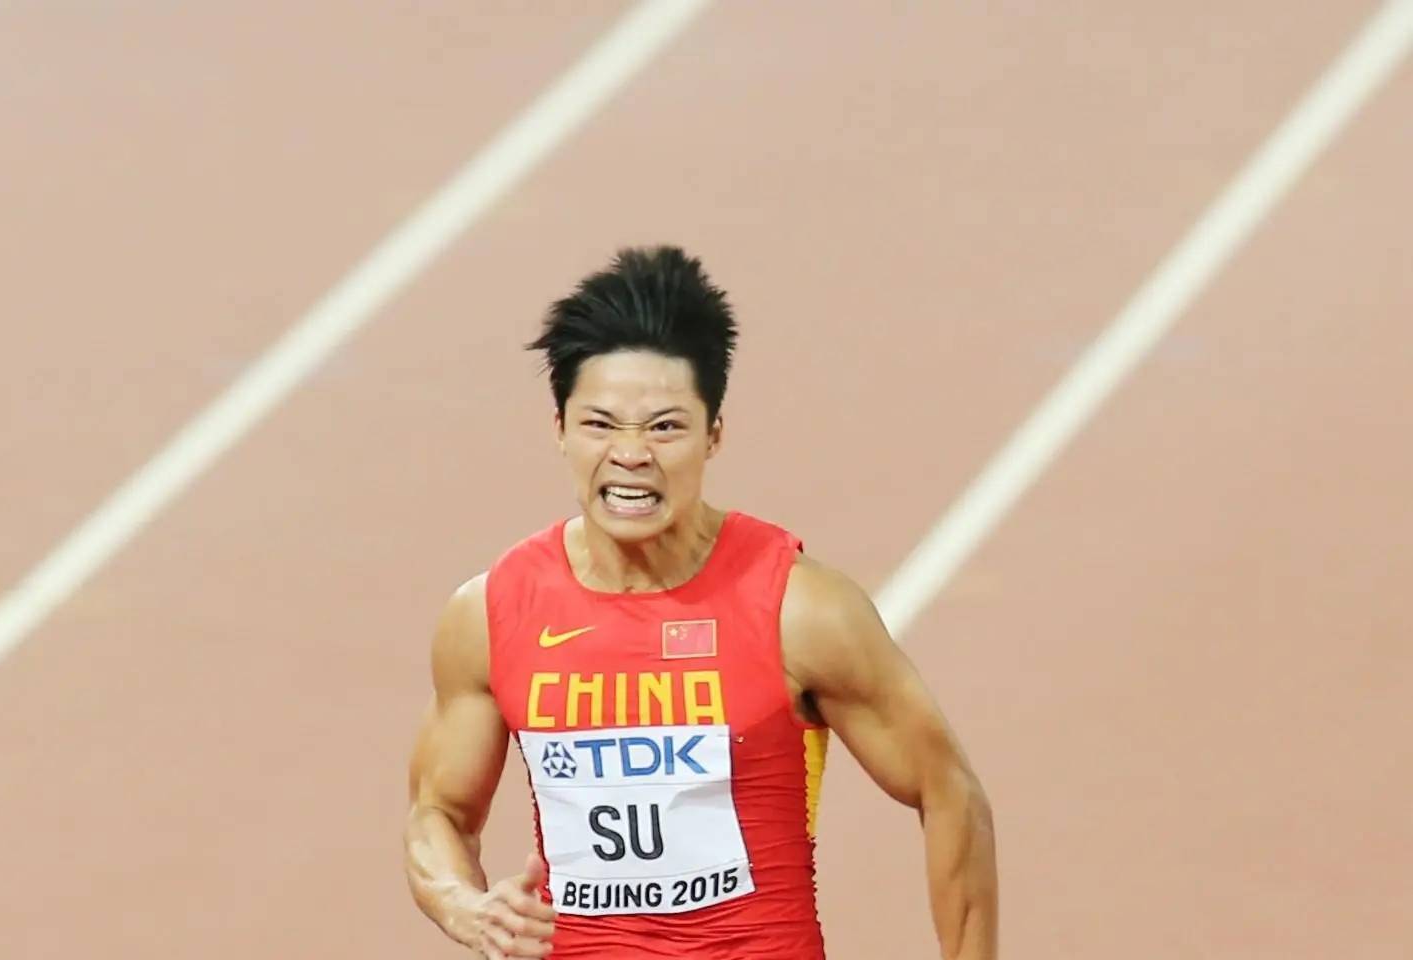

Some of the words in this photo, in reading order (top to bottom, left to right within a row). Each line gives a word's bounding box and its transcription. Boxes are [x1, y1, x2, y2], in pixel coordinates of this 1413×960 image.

[527, 670, 726, 728] CHINA
[574, 734, 710, 779] TDK
[588, 803, 664, 861] SU
[562, 881, 662, 910] BEIJING
[671, 867, 738, 907] 2015
